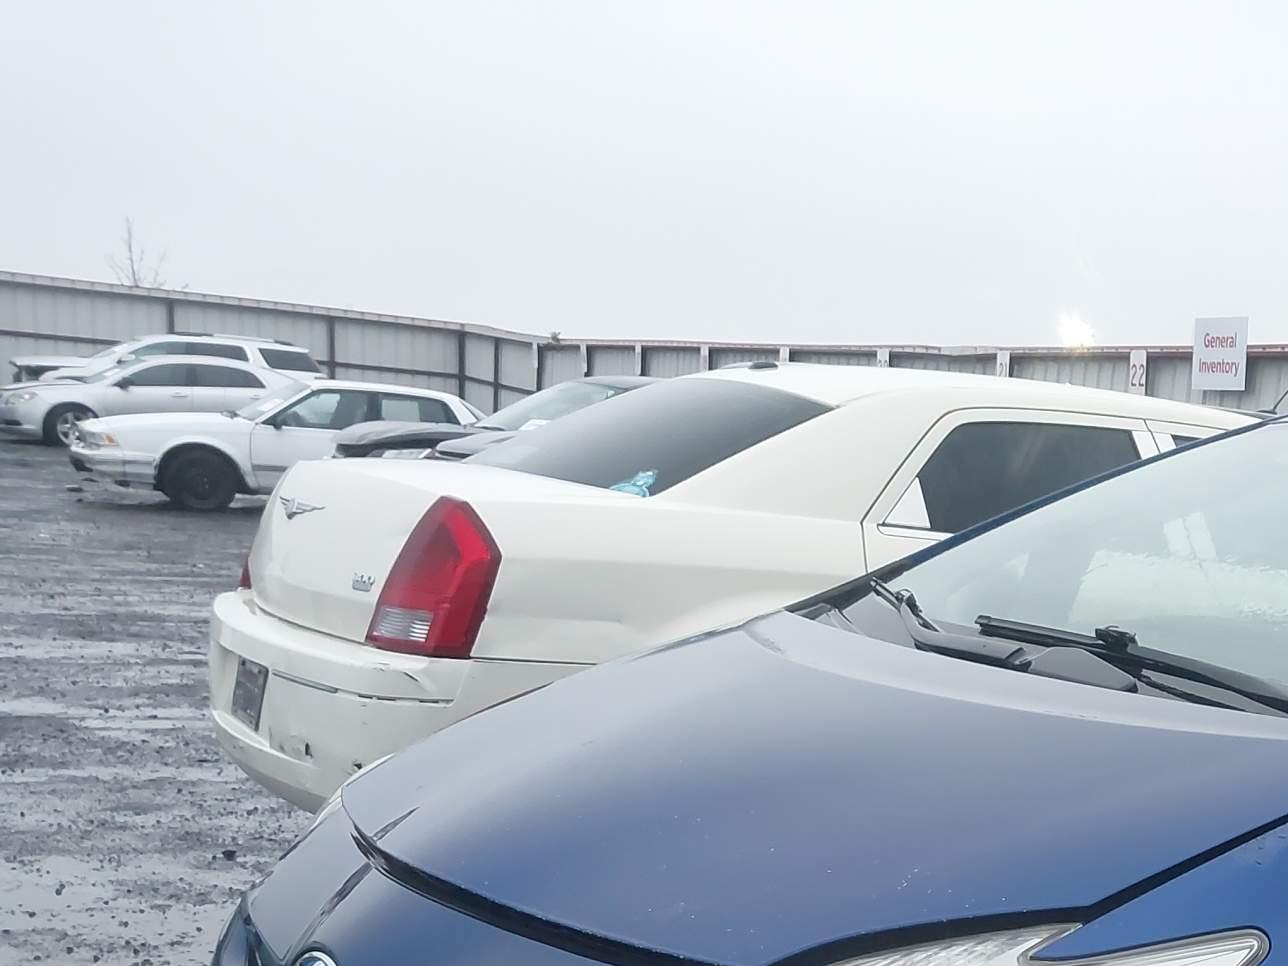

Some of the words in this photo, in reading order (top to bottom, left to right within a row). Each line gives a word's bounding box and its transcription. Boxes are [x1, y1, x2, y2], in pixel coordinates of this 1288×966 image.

[1203, 332, 1238, 348] General
[1130, 363, 1145, 387] 22
[1199, 358, 1240, 376] Inventory
